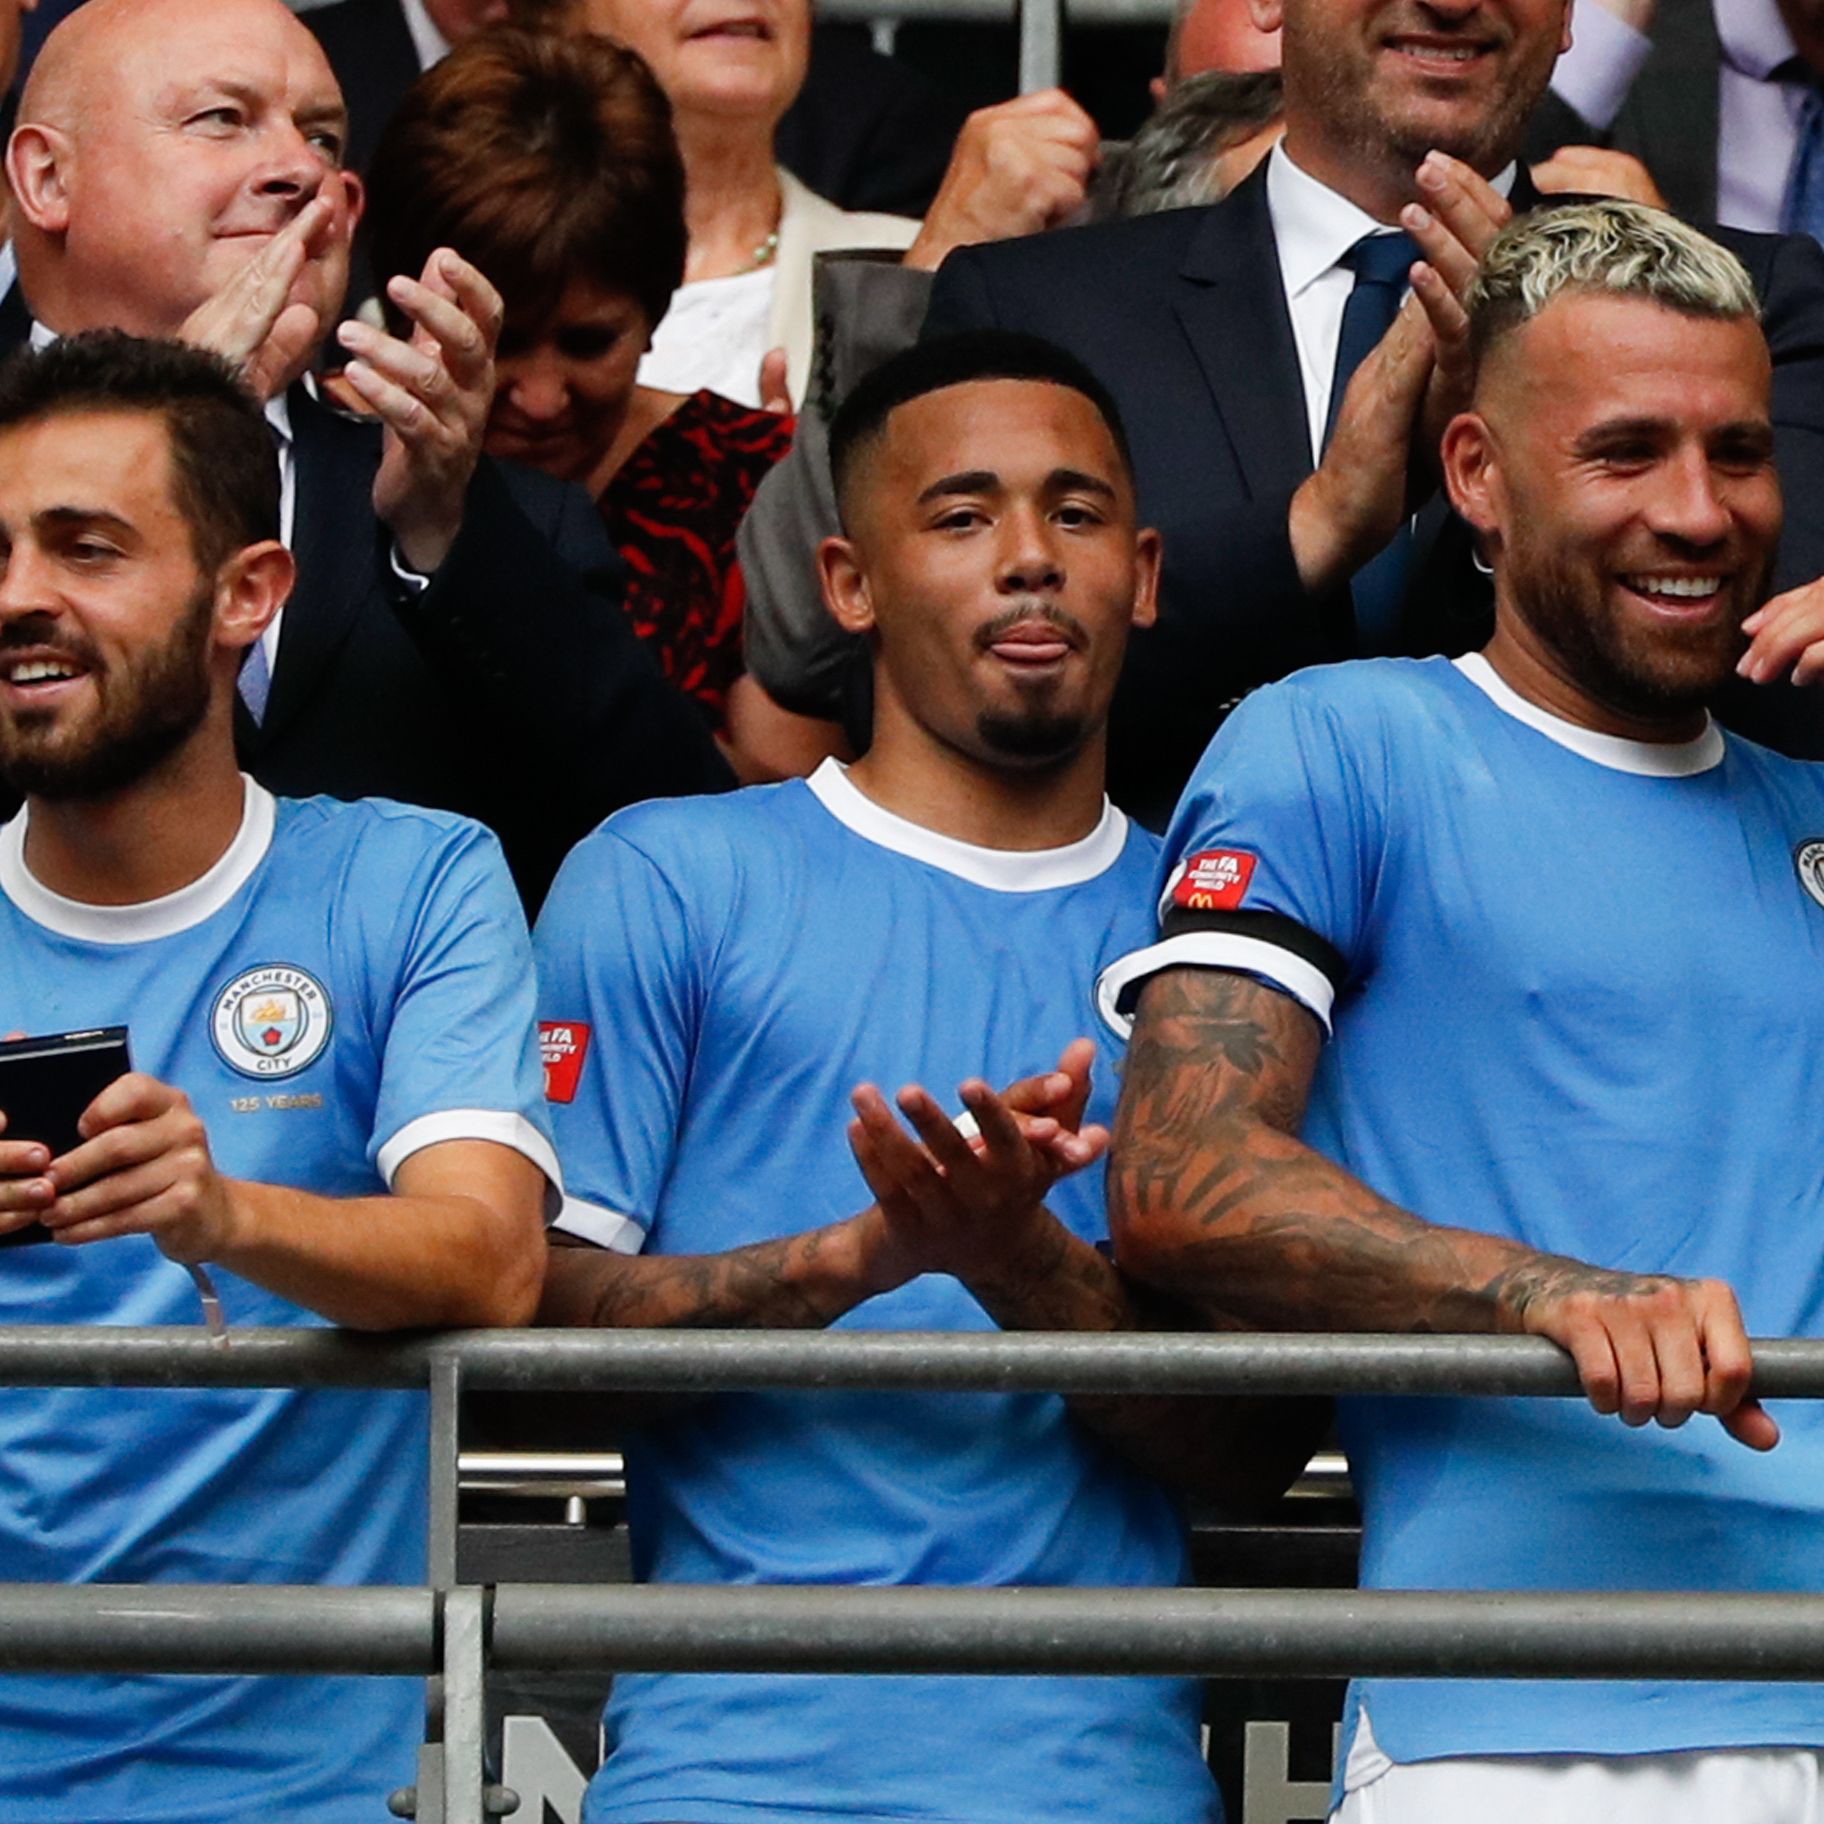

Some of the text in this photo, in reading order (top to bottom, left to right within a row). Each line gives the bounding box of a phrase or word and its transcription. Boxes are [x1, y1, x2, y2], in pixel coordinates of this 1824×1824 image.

[1218, 856, 1238, 873] FA
[222, 972, 318, 1011] MANCHESTER
[552, 1028, 572, 1043] FA
[257, 1057, 292, 1072] CITY
[231, 1093, 322, 1113] 125 YEARS
